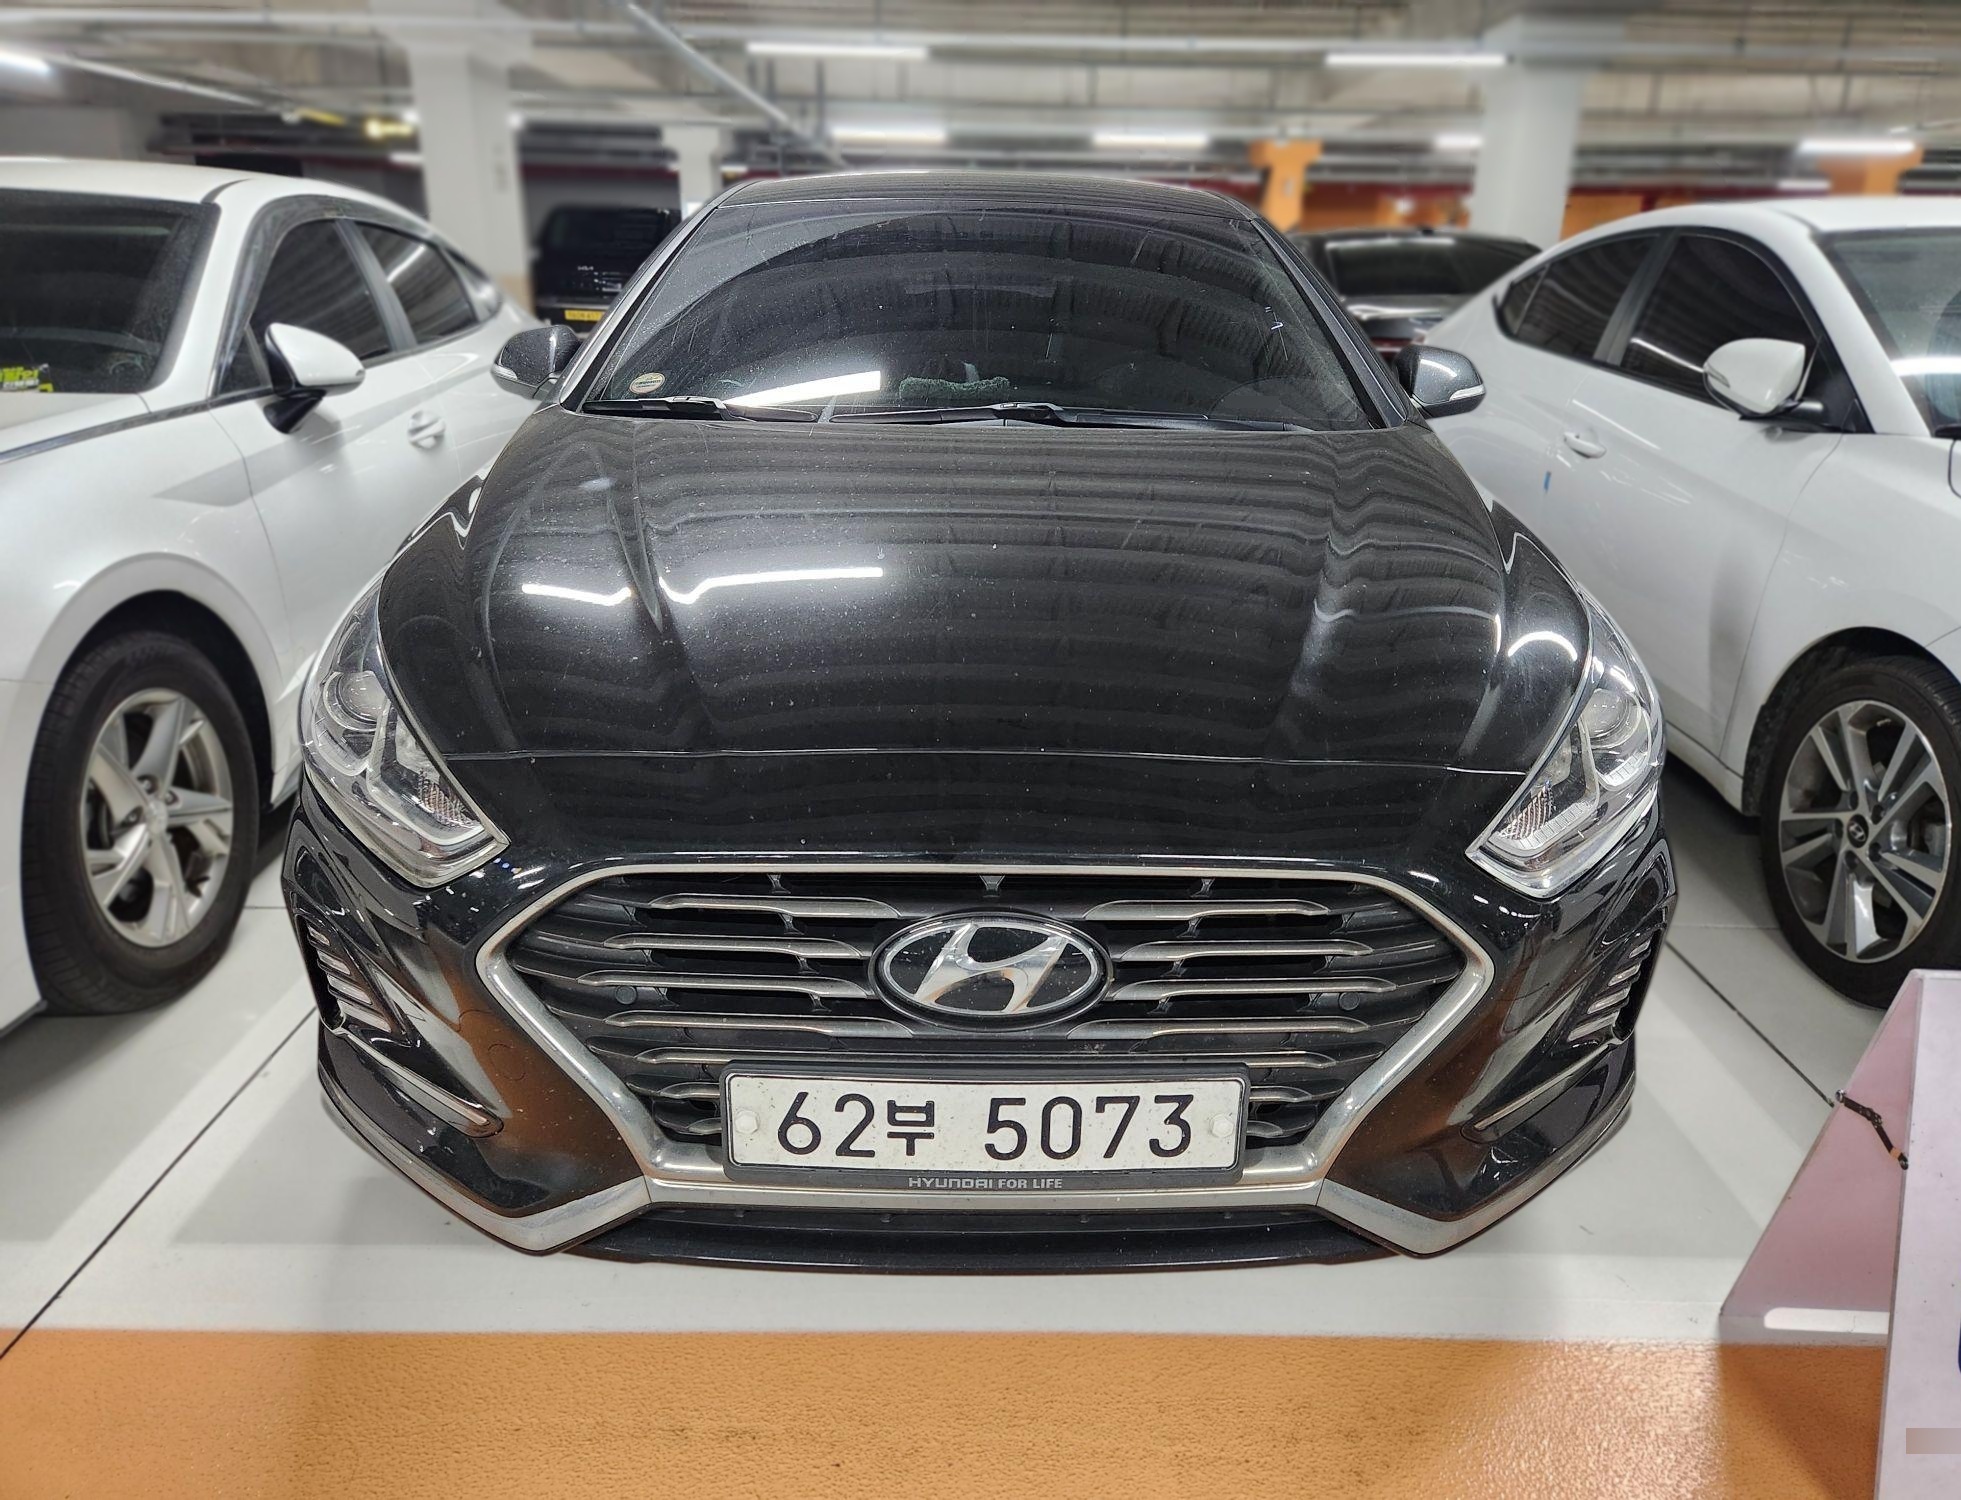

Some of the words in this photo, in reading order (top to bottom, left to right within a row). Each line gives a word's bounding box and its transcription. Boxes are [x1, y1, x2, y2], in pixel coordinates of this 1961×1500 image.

[777, 1091, 935, 1159] 62부
[984, 1093, 1195, 1161] 5073
[908, 1176, 993, 1188] HYUNDAI
[999, 1178, 1028, 1189] FOR
[1033, 1178, 1063, 1189] LIFE
